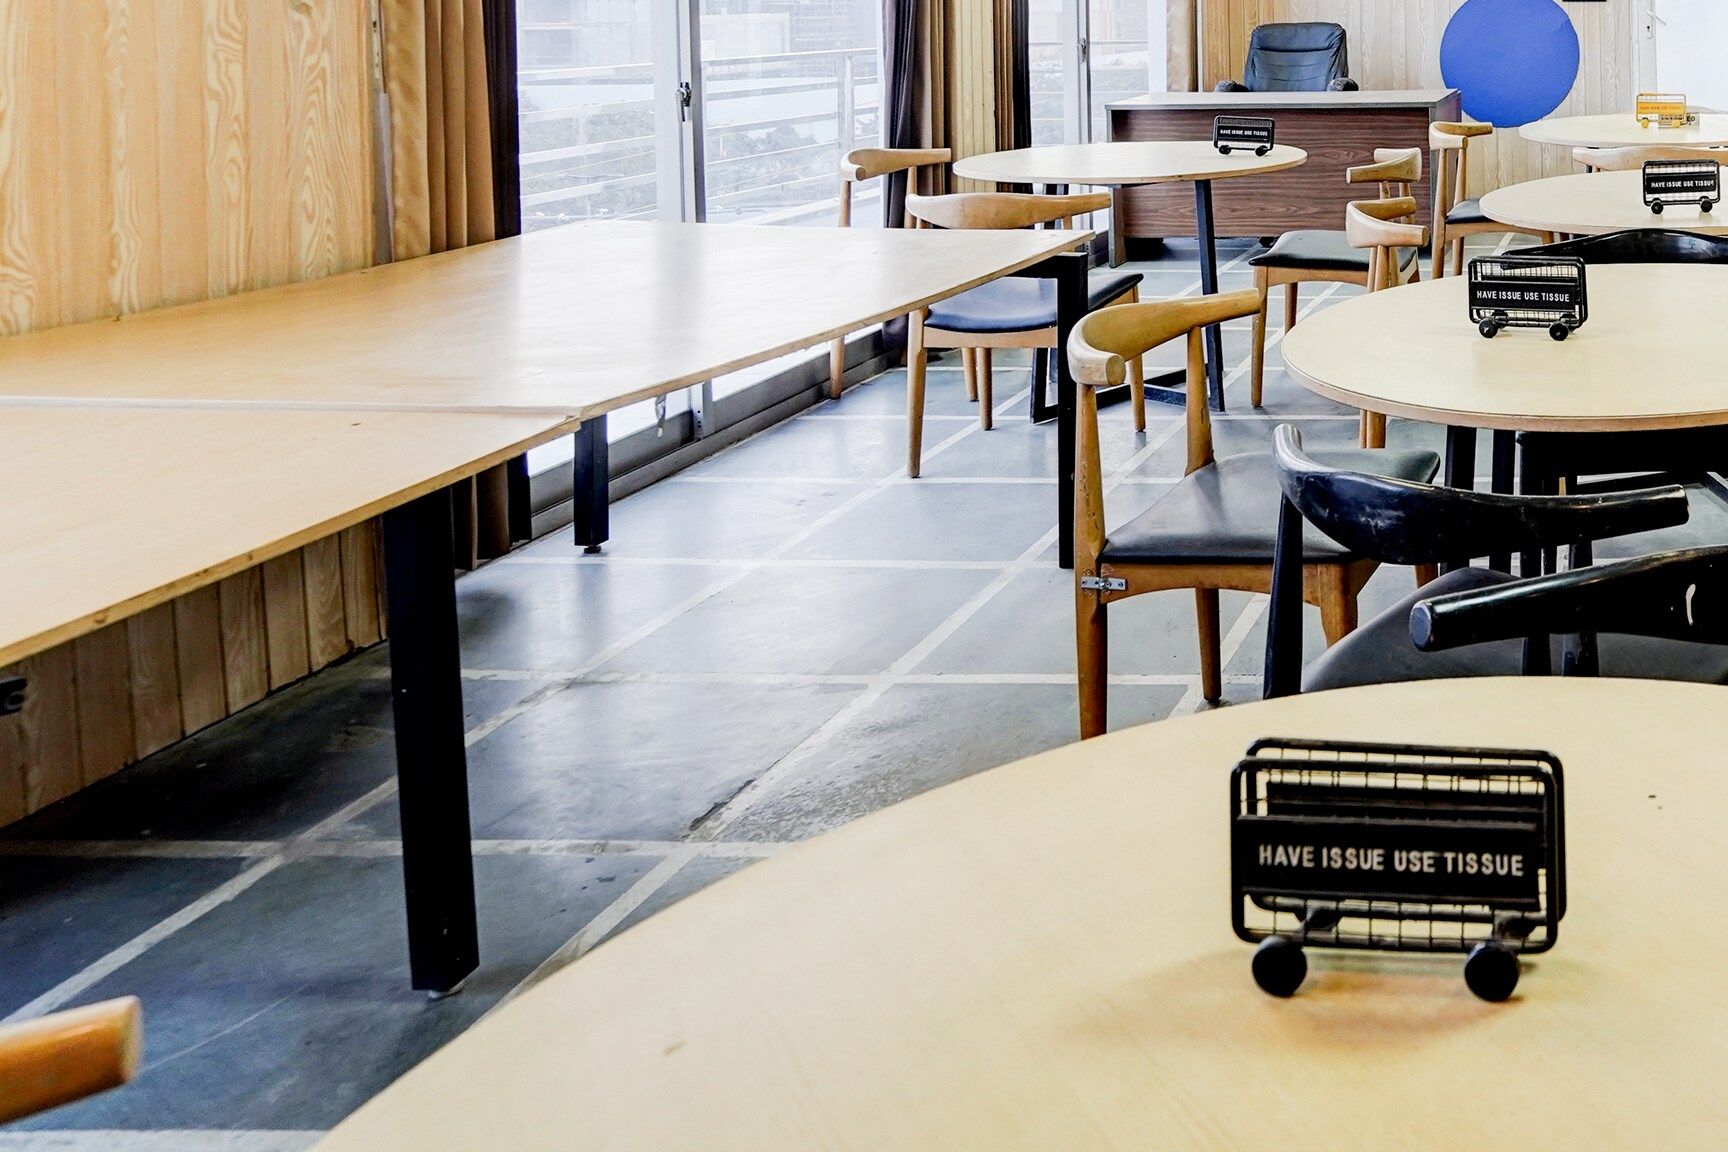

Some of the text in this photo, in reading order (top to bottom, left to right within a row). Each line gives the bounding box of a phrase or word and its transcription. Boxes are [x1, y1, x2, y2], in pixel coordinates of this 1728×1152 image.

[1695, 179, 1715, 187] TISSUE
[1476, 290, 1570, 302] HAVE ISSUE USE TISSUE
[1258, 844, 1524, 877] HAVE ISSUE USE TISSUE
